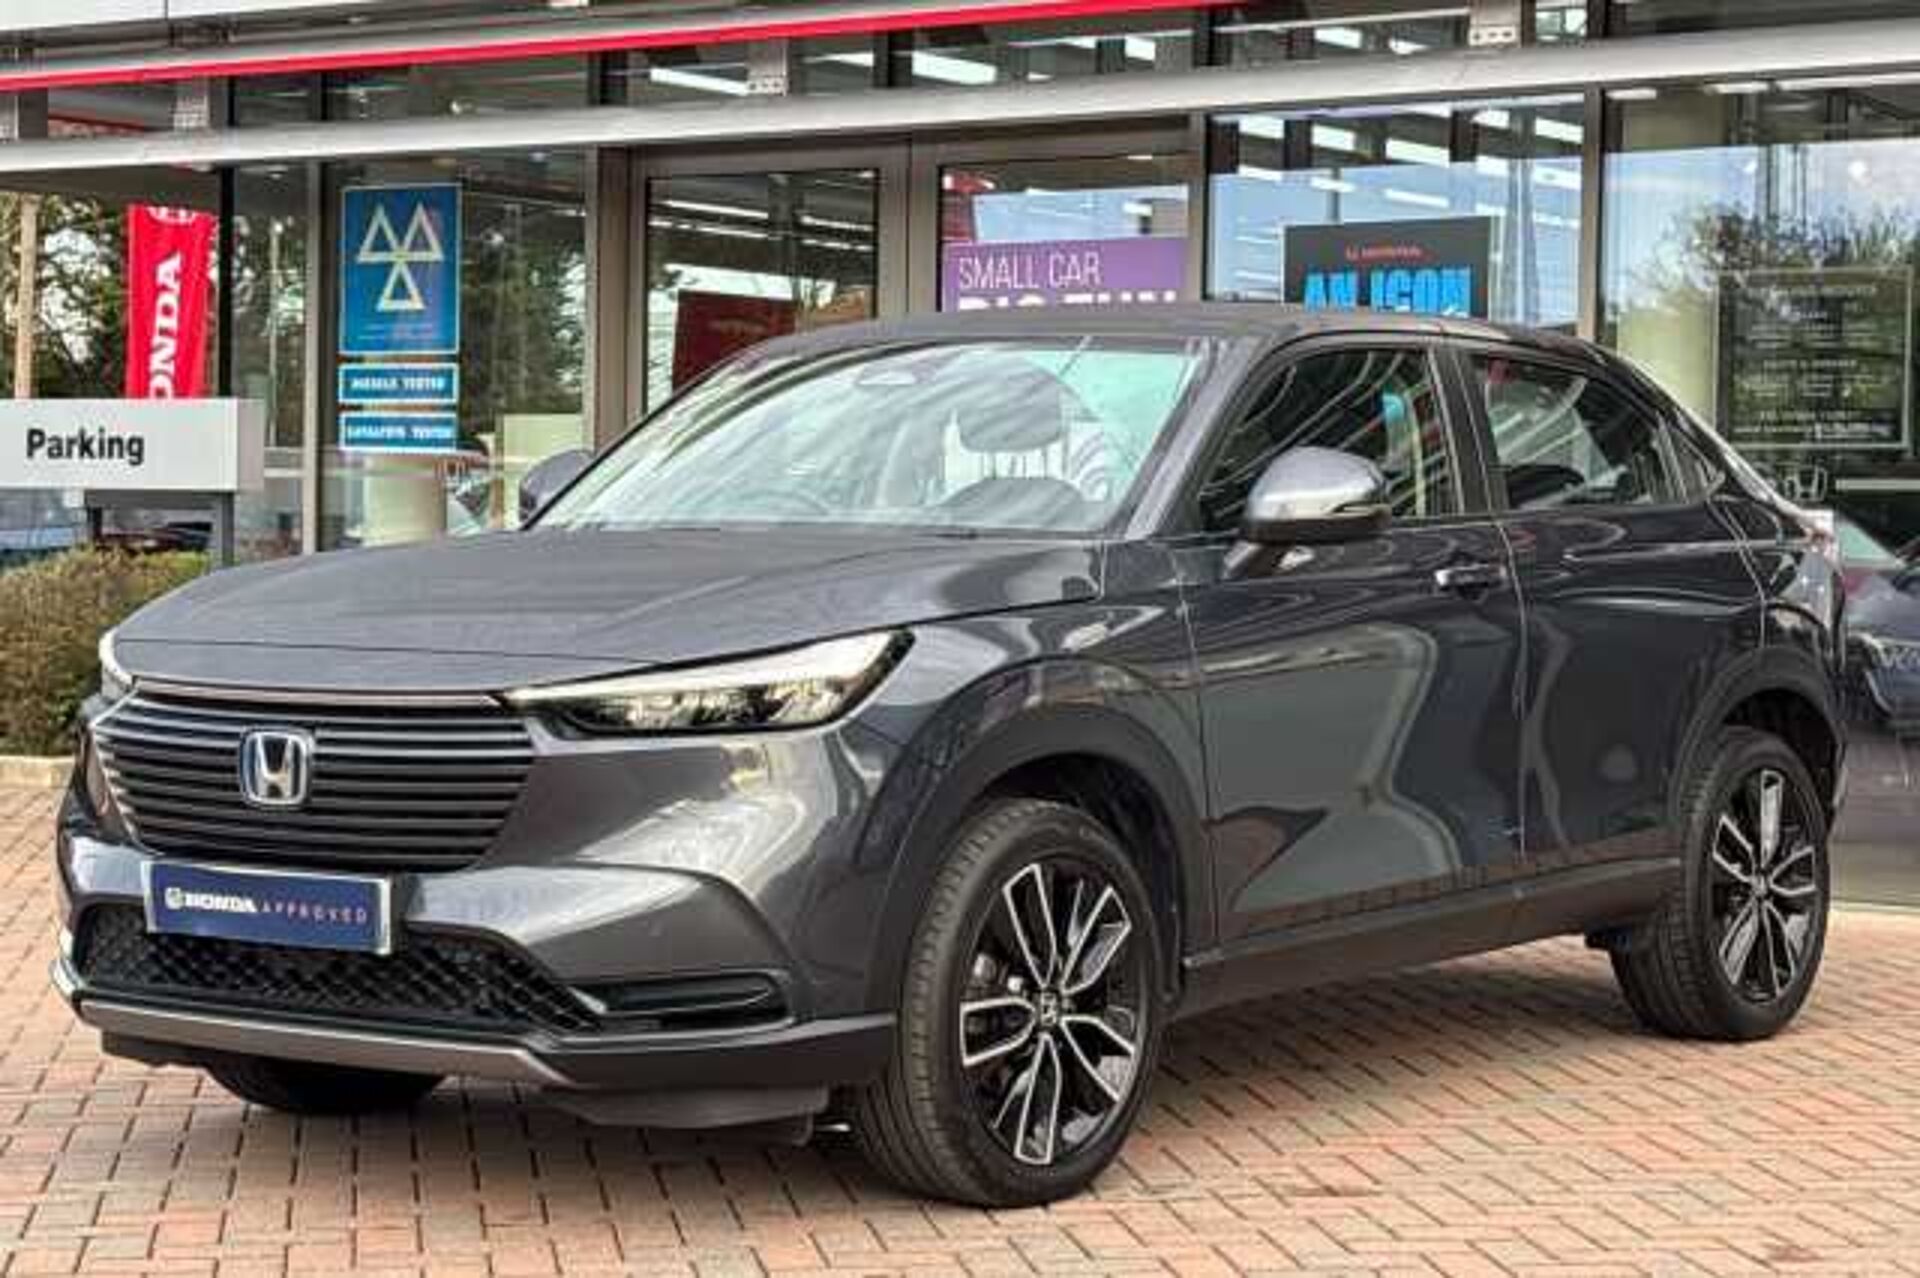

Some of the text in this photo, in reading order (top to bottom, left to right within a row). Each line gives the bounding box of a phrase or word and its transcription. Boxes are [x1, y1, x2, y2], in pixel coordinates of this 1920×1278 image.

[958, 250, 1101, 289] SMALL CAR
[1304, 266, 1471, 316] AN ICON
[149, 248, 182, 399] ONDA
[26, 426, 145, 466] Parking
[184, 891, 368, 924] HONDA APPROVED
